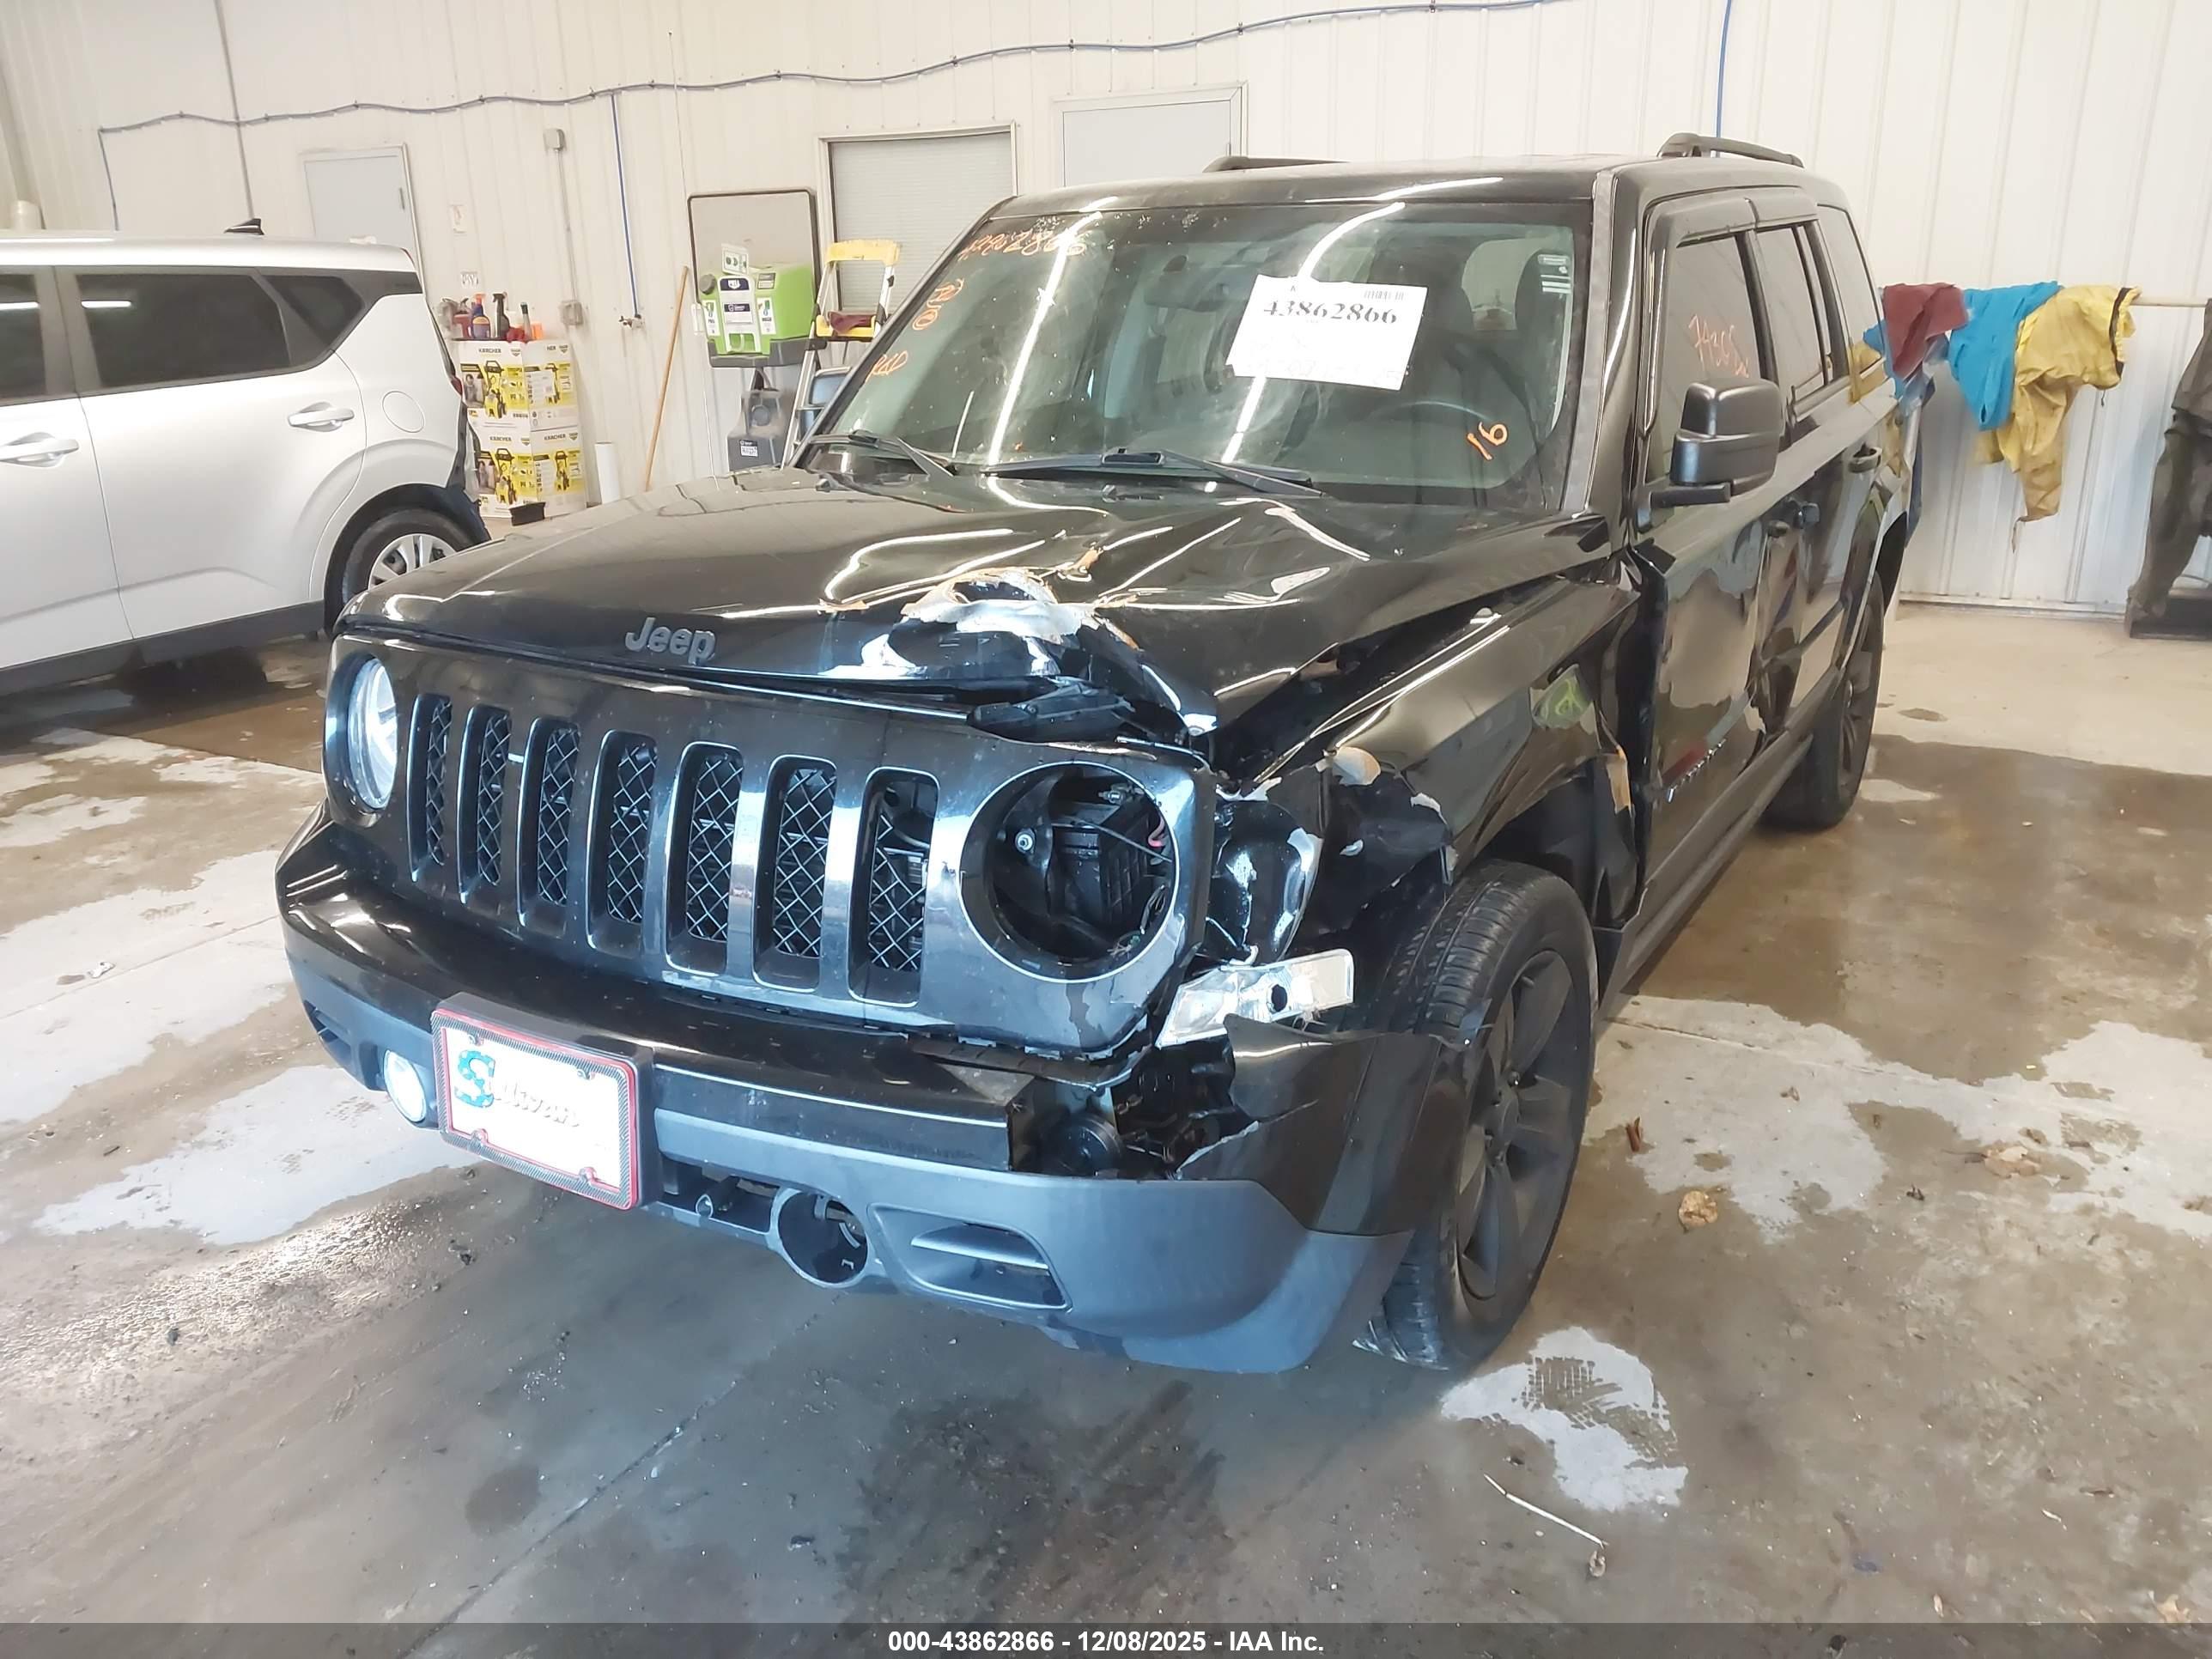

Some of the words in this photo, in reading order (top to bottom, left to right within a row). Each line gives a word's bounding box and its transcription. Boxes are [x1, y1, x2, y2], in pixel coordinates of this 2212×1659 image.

[1262, 300, 1398, 324] 43862866
[1466, 421, 1509, 461] 16
[624, 616, 716, 666] Jeep
